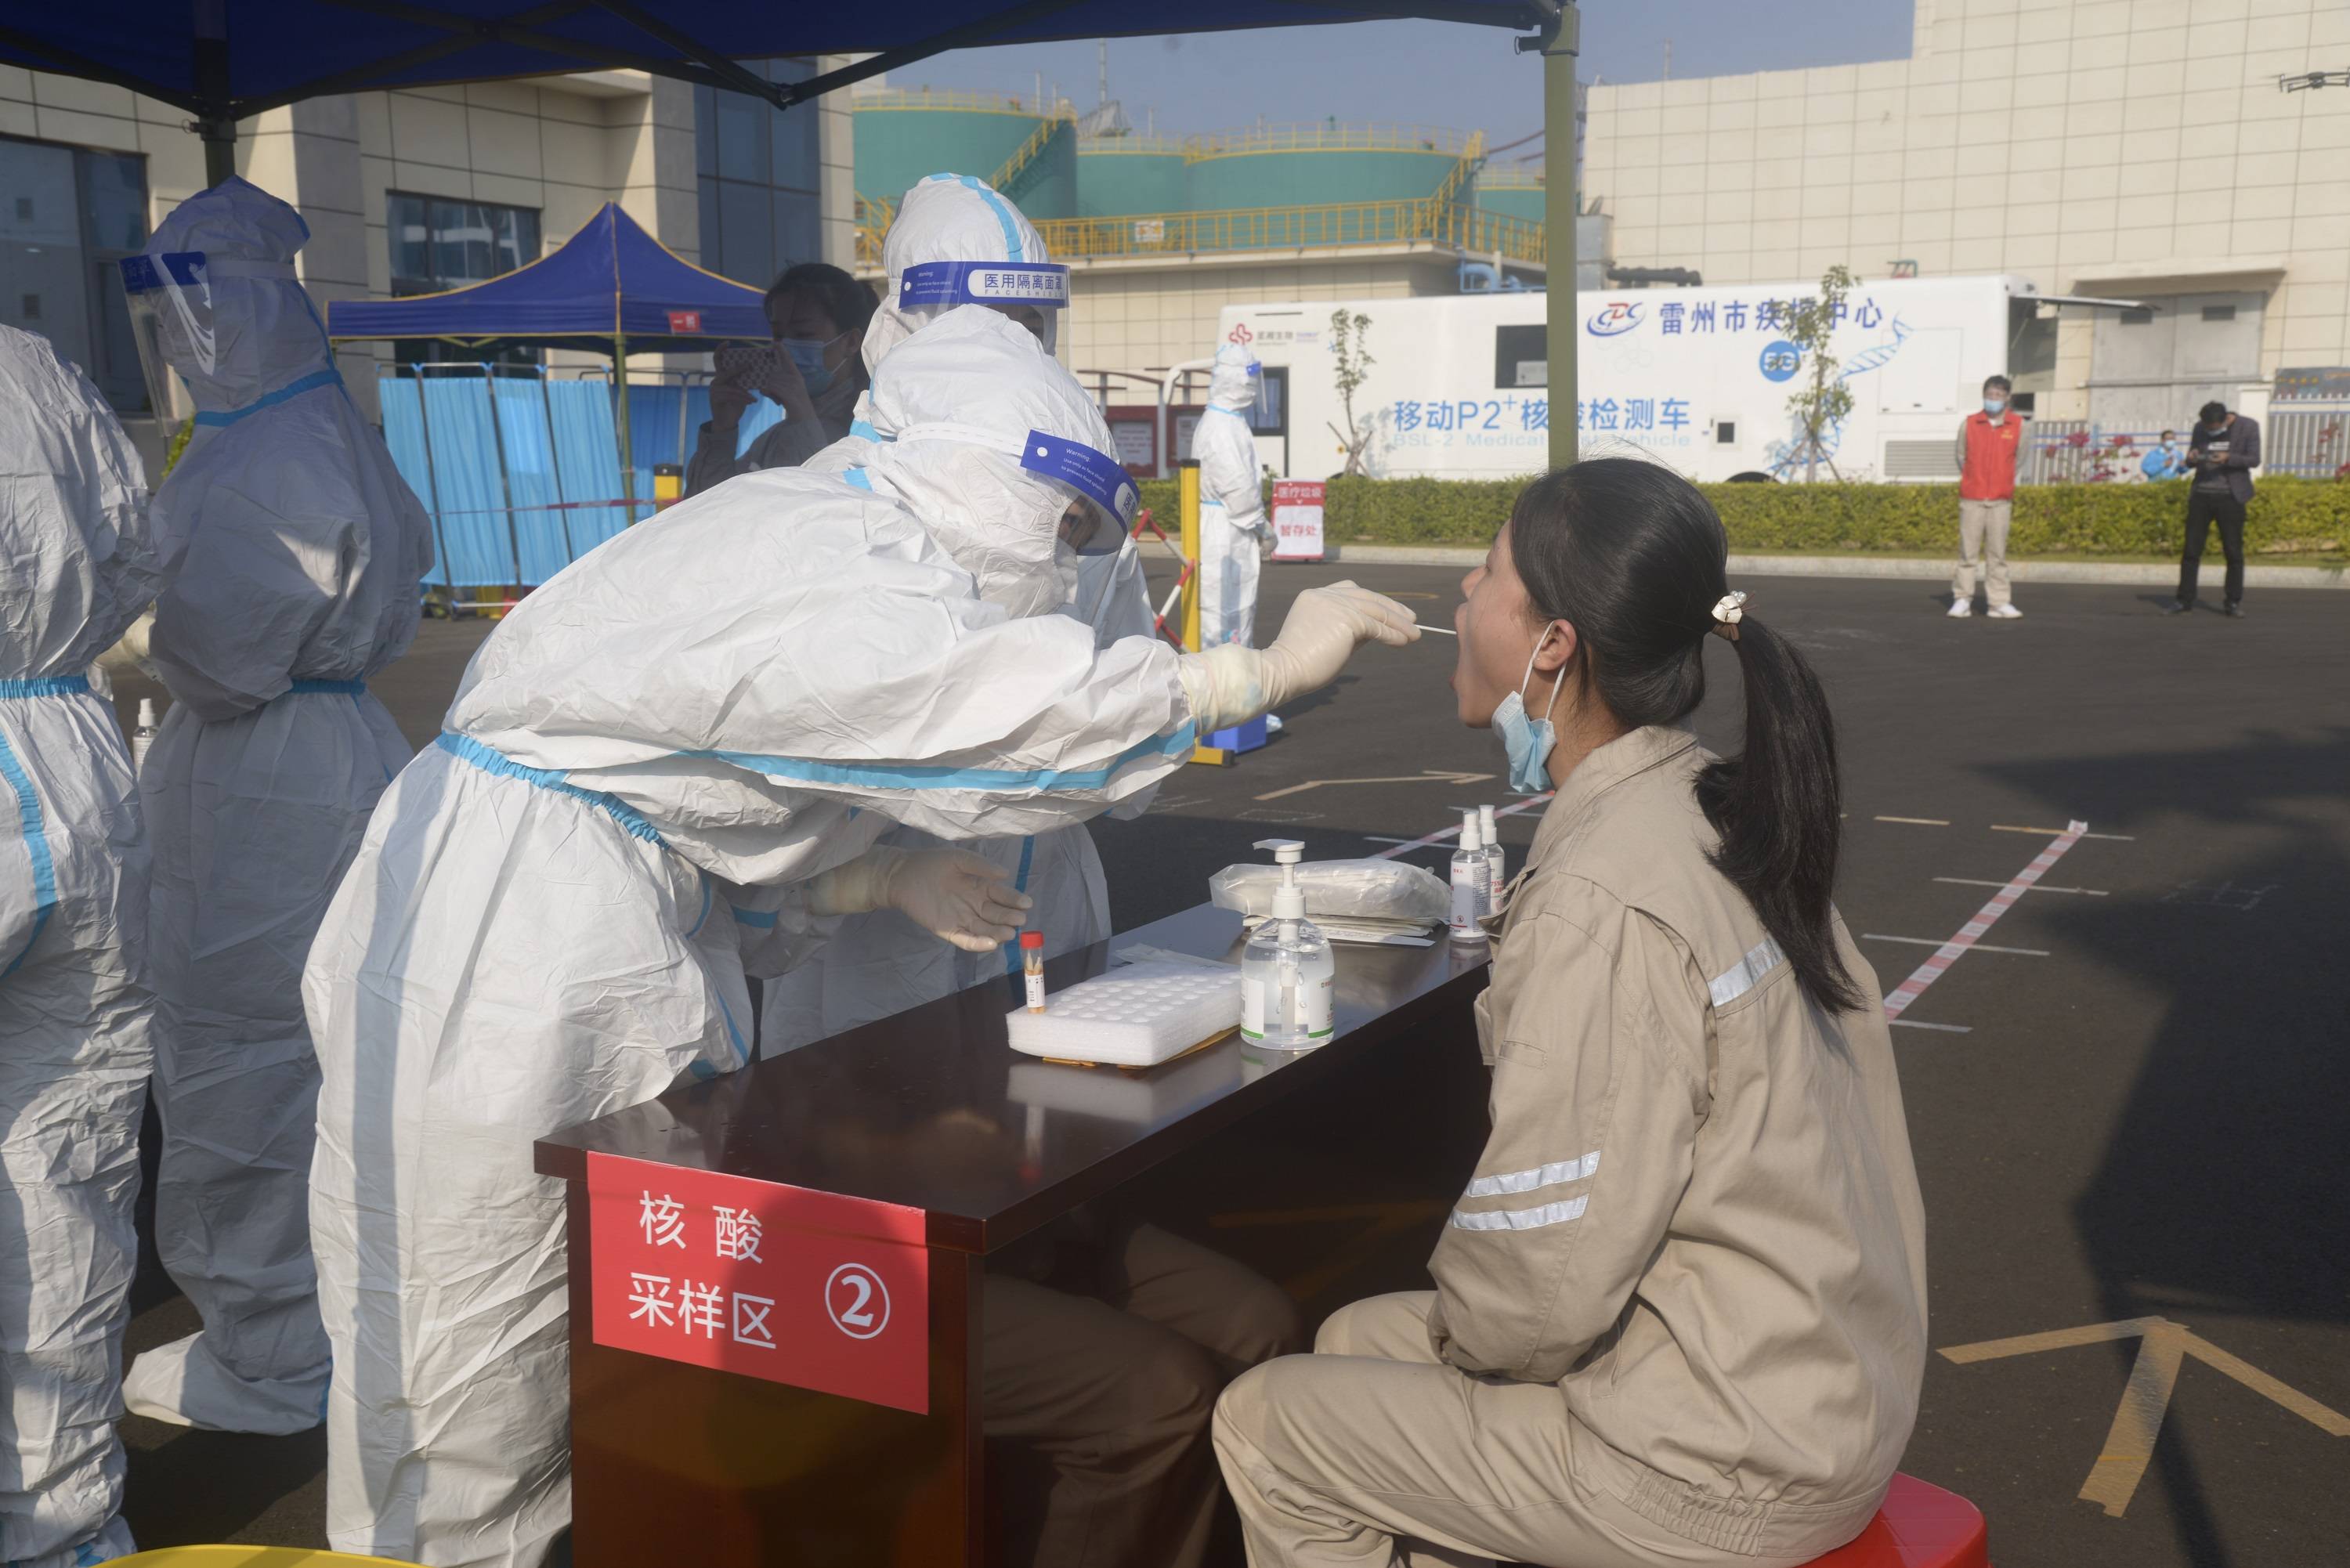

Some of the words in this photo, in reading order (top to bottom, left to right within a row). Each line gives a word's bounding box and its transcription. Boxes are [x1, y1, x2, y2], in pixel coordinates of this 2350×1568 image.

[985, 273, 1062, 290] 医用隔离面罩
[1763, 352, 1796, 372] 5G
[1393, 433, 1455, 447] BSL-2
[1065, 448, 1091, 462] Warning:
[1278, 486, 1322, 499] 医疗垃圾
[1281, 525, 1316, 537] 暂存处
[639, 1190, 764, 1264] 核酸
[628, 1272, 777, 1349] 采样区
